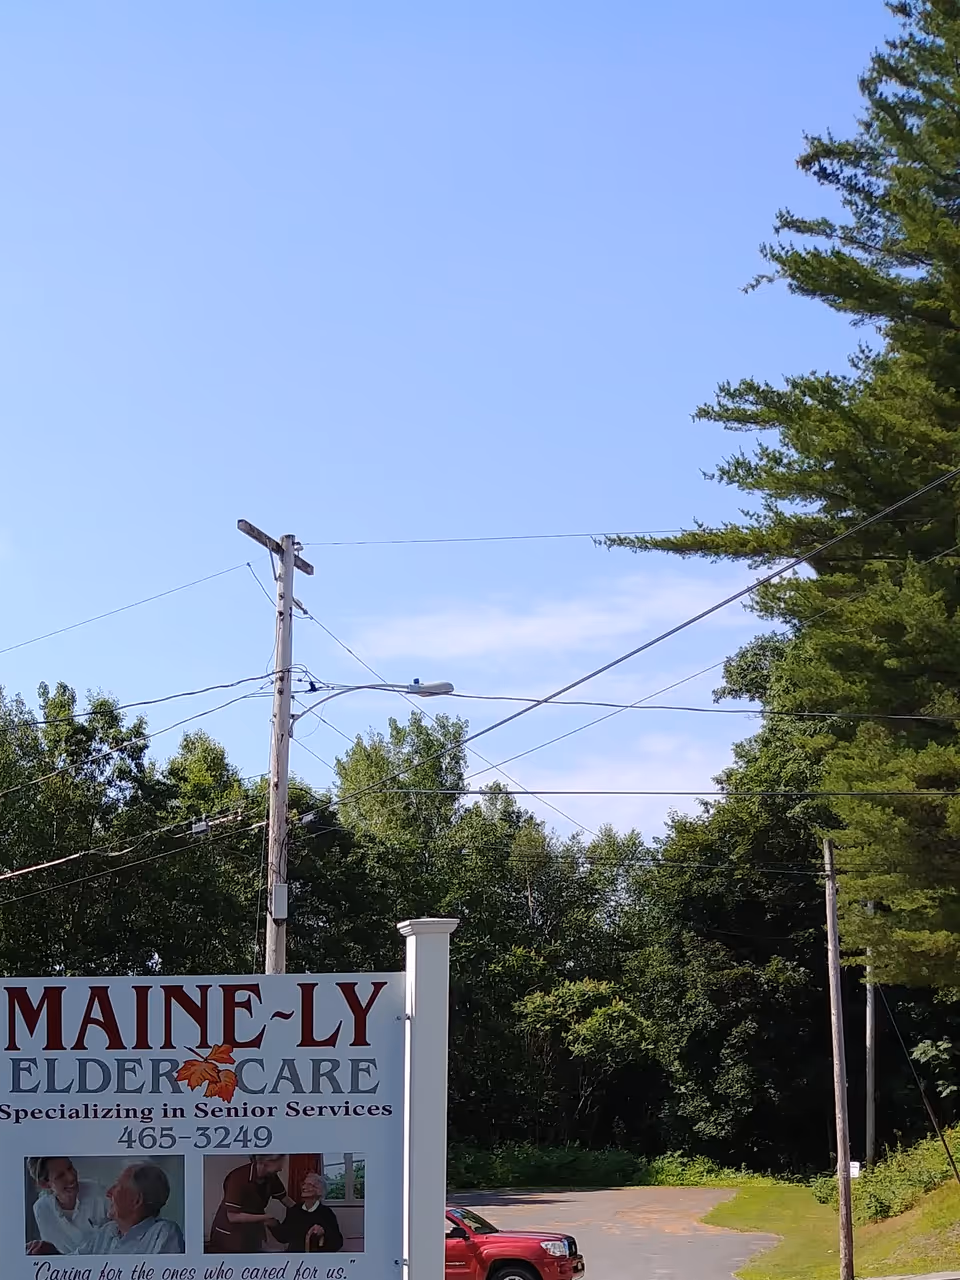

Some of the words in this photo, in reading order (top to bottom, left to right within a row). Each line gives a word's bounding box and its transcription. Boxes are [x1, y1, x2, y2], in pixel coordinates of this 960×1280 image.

[9, 1057, 185, 1094] ELDER
[234, 1057, 380, 1095] CARE
[161, 1103, 187, 1119] in
[194, 1102, 278, 1118] Senior
[285, 1100, 393, 1117] Services
[117, 1125, 273, 1149] 465-3249
[131, 1262, 155, 1280] the
[161, 1267, 197, 1280] ones
[203, 1260, 234, 1280] who
[241, 1260, 290, 1280] cared
